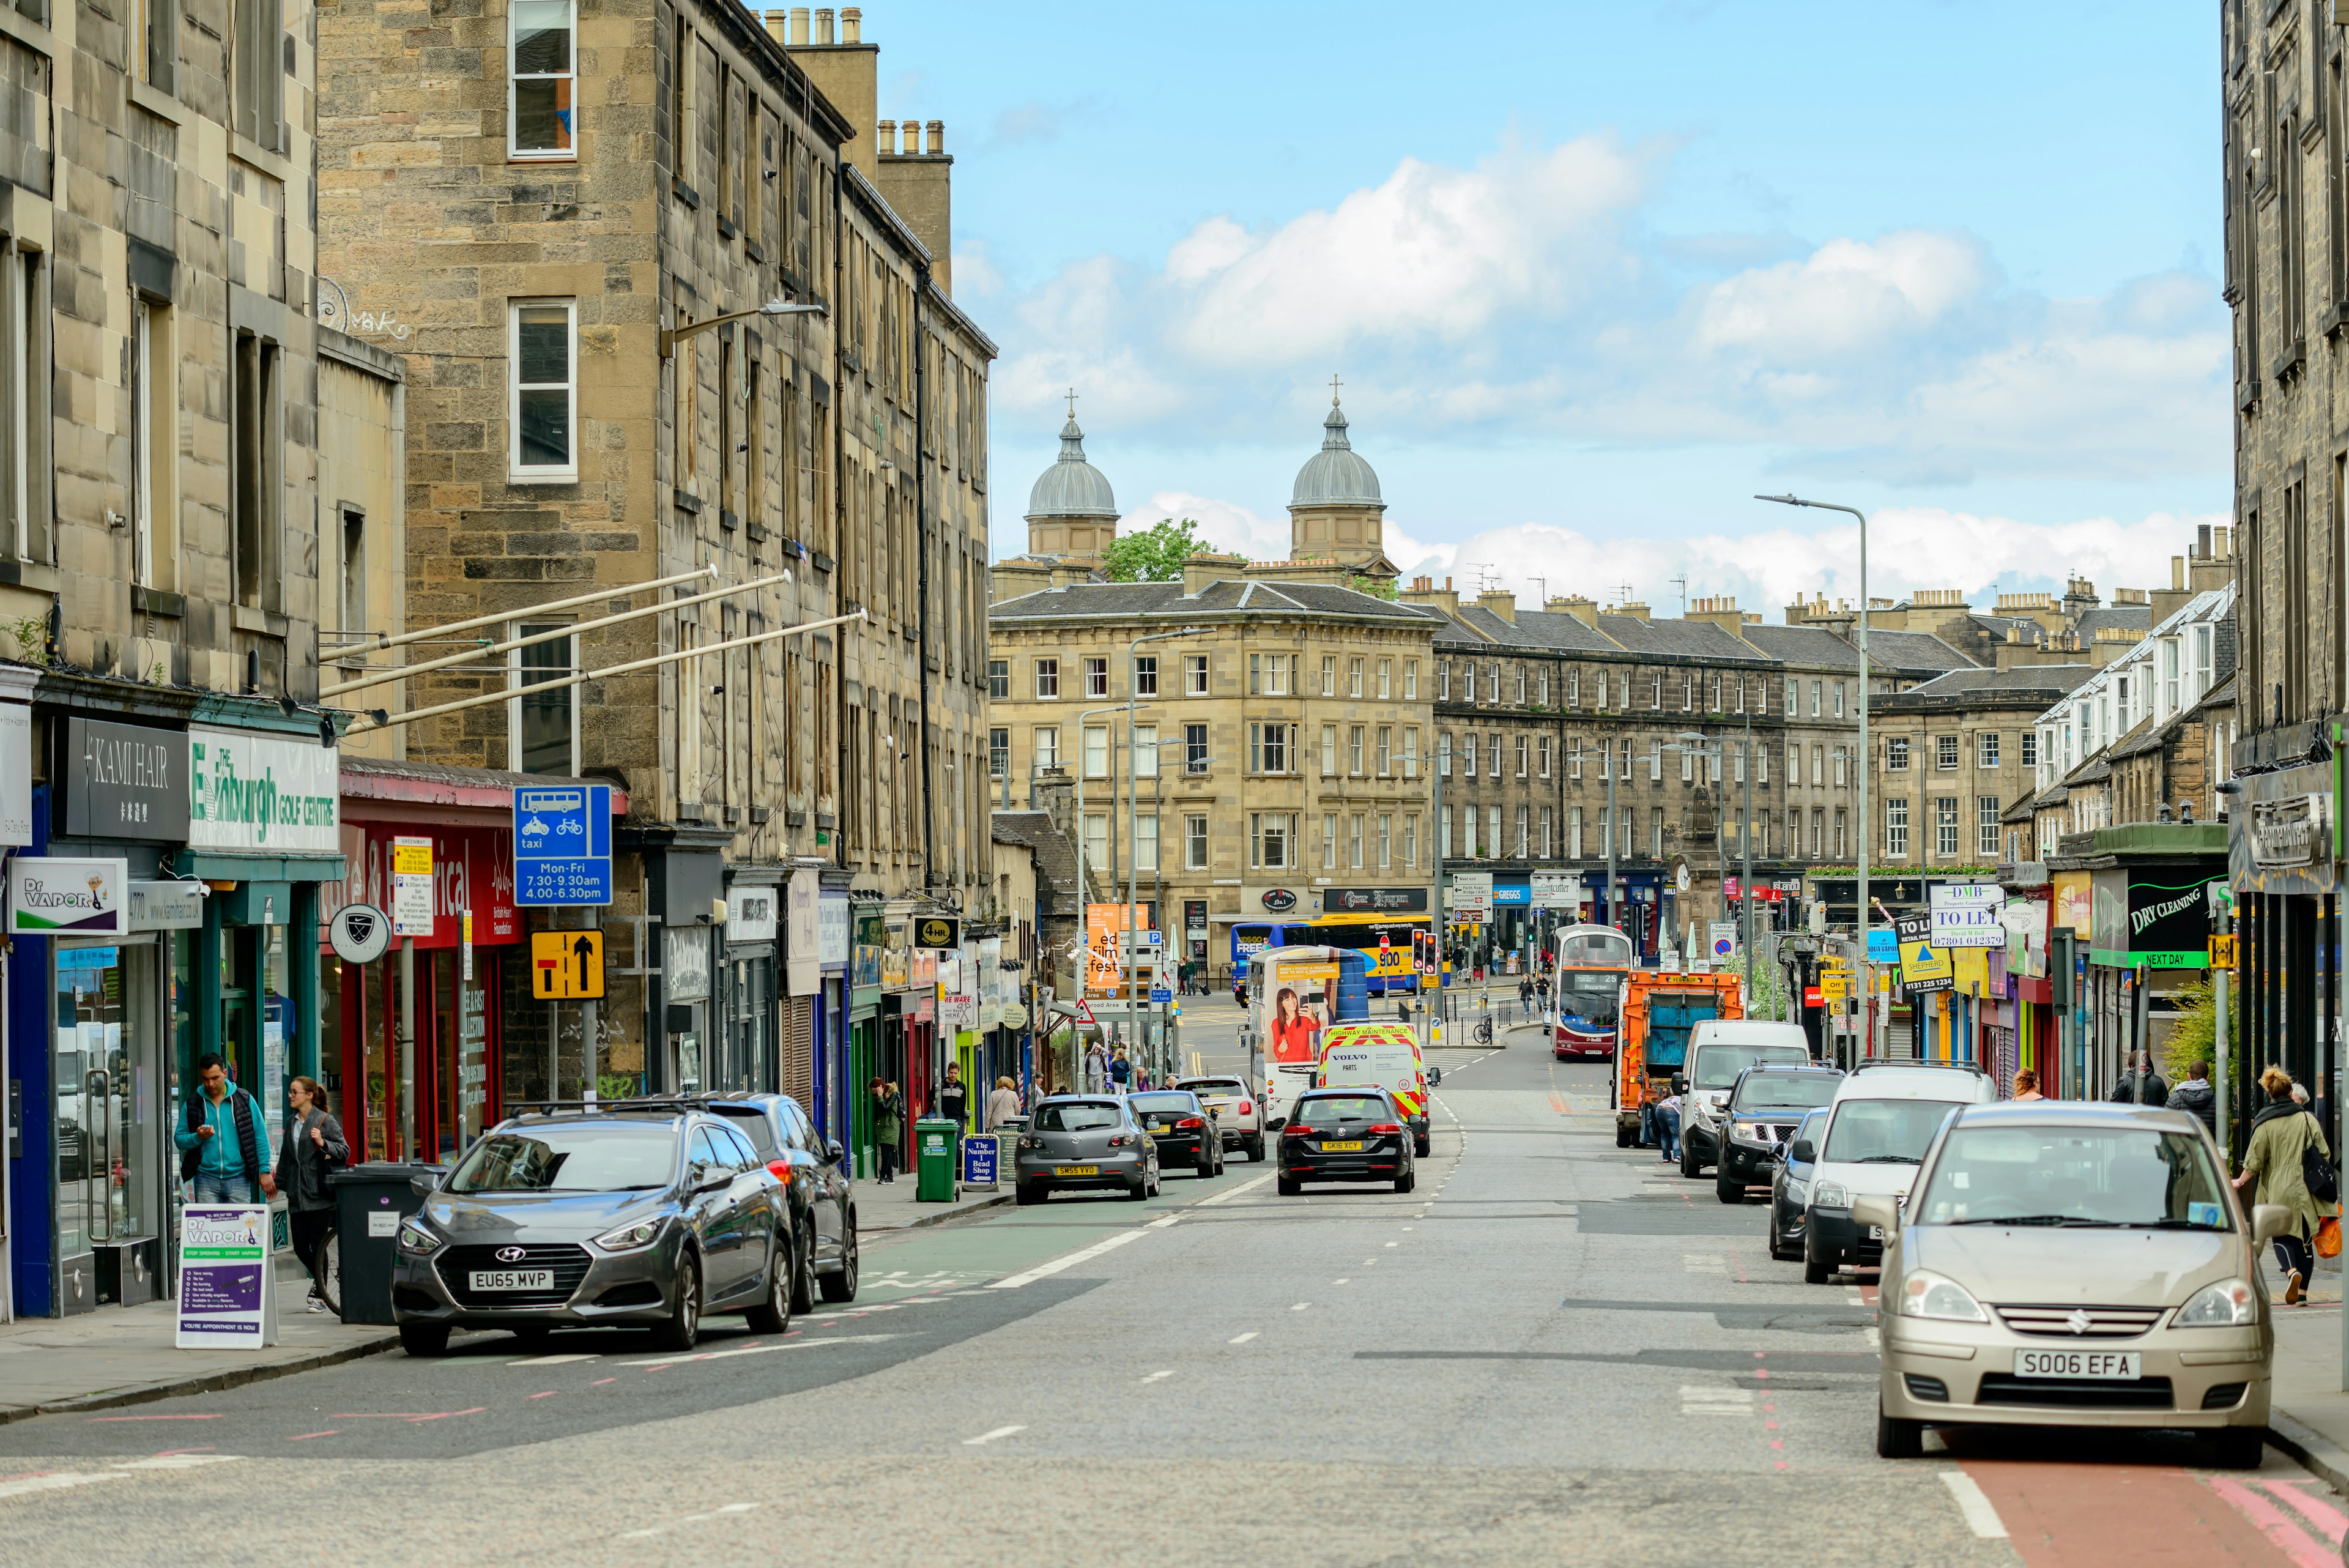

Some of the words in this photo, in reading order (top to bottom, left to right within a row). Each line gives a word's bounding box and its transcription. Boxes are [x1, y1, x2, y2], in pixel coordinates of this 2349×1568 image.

[95, 738, 132, 786] KAMI
[135, 743, 169, 789] HAIR
[219, 748, 230, 767] THE
[279, 795, 301, 825] GOLF
[304, 796, 334, 827] CENTRE
[521, 838, 542, 848] taxi
[541, 863, 585, 873] Mon-Fri
[24, 878, 43, 892] Dr
[527, 875, 600, 886] 7.30-9.30am
[525, 888, 601, 899] 4.00-6.30pm
[1264, 892, 1276, 901] Omar
[1499, 890, 1521, 899] GREGGS
[1953, 886, 1982, 897] DMB
[24, 893, 91, 908] VAPOR
[1345, 890, 1369, 908] Omar
[150, 898, 199, 920] www.kamihair.co.uk
[494, 907, 503, 918] British
[503, 908, 512, 918] Heart
[2131, 905, 2157, 936] DRY
[2156, 888, 2202, 918] CLEANING
[1937, 912, 1961, 926] TO
[1967, 911, 1997, 925] LET
[494, 922, 512, 935] Foundation
[1899, 921, 1917, 934] TO
[930, 938, 951, 946] CLEANING
[1100, 932, 1117, 945] ed
[1934, 937, 1963, 946] 07804
[1967, 936, 2002, 945] 042379
[1093, 946, 1118, 958] film
[1236, 943, 1263, 953] FREE
[1379, 951, 1400, 967] 900
[1909, 960, 1944, 970] SHEPHERD
[2147, 954, 2167, 965] NEXT
[2169, 954, 2184, 965] DAY
[1089, 960, 1118, 972] fest
[1912, 970, 1943, 979] Commercial
[475, 989, 485, 1011] FAST
[188, 1219, 204, 1230] Dr
[187, 1231, 246, 1243] VAPOR
[476, 1273, 514, 1287] EU65
[518, 1273, 546, 1287] MVP
[2088, 1356, 2130, 1375] EFA
